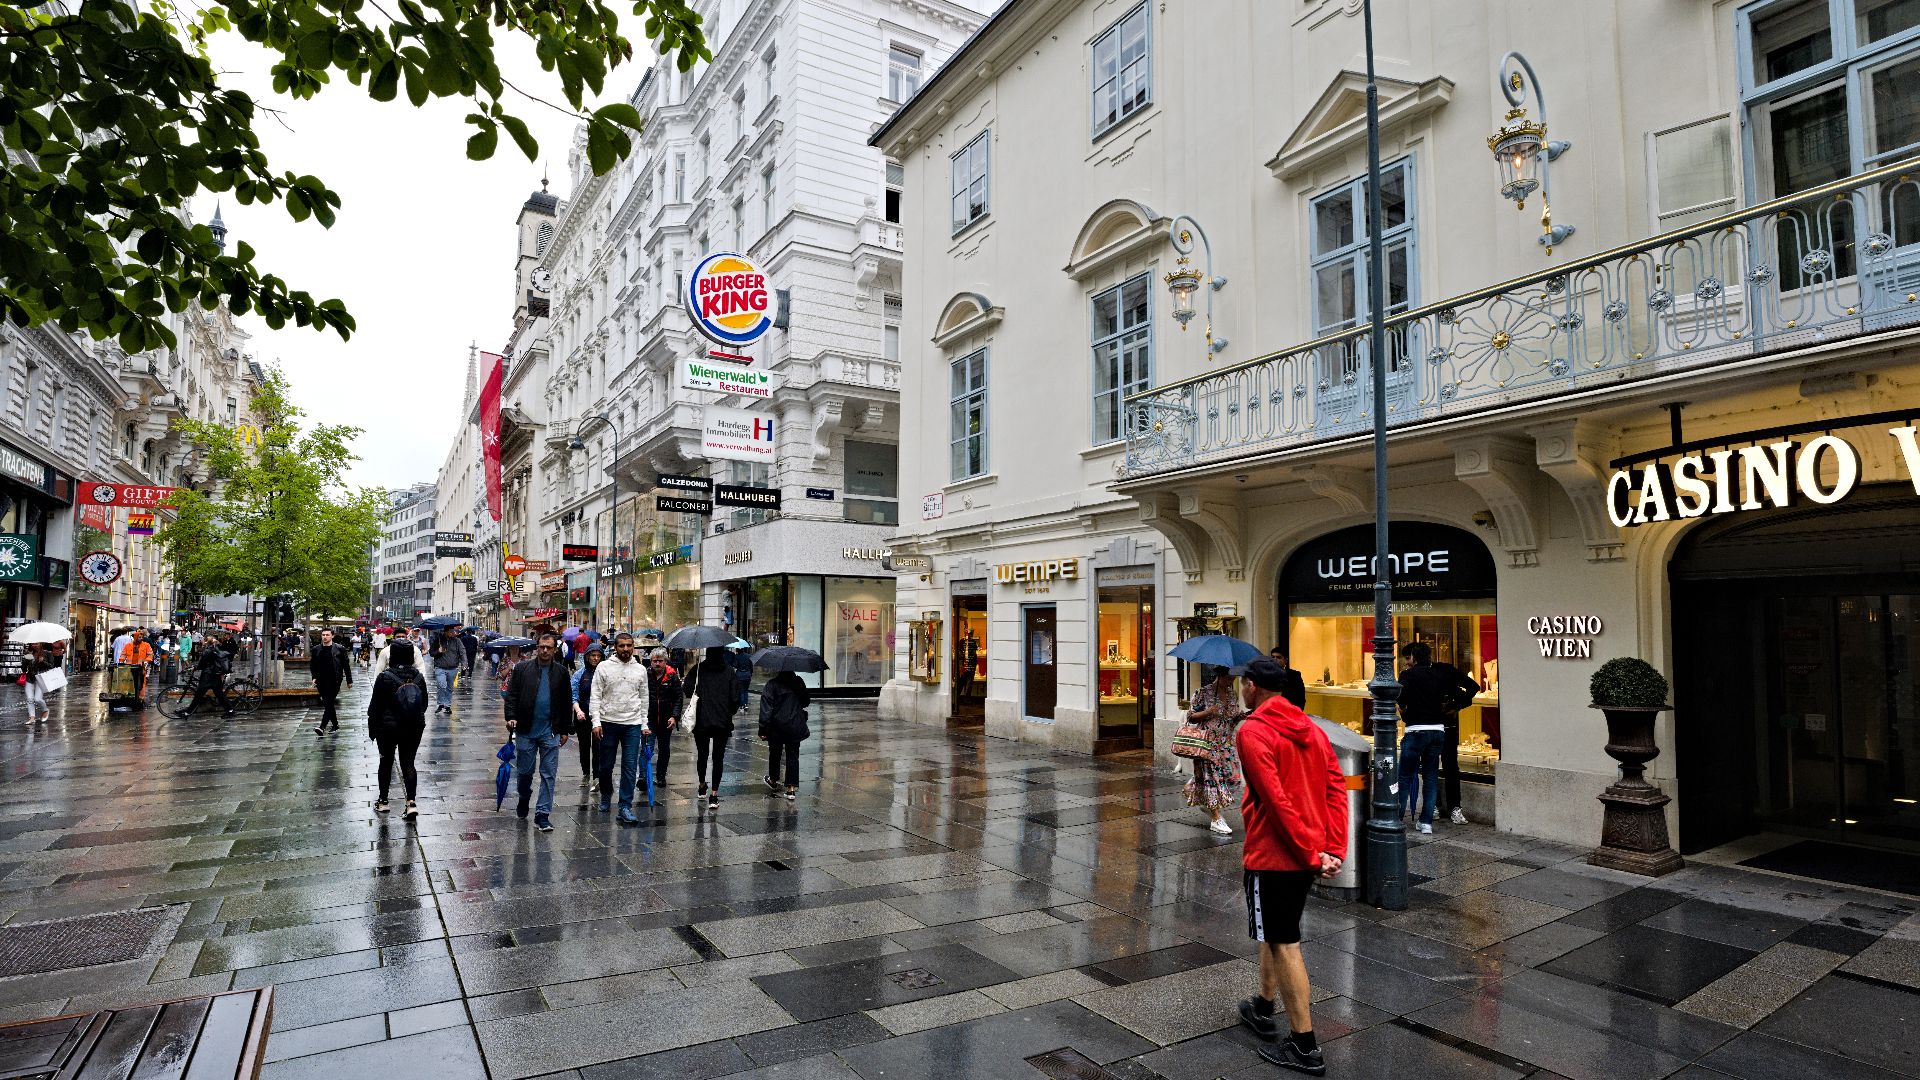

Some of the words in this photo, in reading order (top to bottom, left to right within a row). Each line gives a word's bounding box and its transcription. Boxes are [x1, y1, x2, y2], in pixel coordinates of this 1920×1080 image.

[699, 274, 765, 296] BURGER
[702, 289, 768, 319] KING
[688, 363, 756, 384] Wienerwald
[719, 381, 769, 397] Restaurant
[706, 427, 751, 440] Immobilien
[753, 417, 773, 442] H
[2, 449, 40, 484] TRACHTEN
[661, 477, 708, 488] CALZEDONIA
[1607, 435, 1860, 528] CASINO
[660, 500, 709, 511] FALCONERI
[720, 491, 776, 503] HALLHUBER
[85, 554, 118, 566] PLANET
[1317, 550, 1449, 579] WEMPE
[84, 570, 116, 582] VIENNA
[995, 559, 1077, 583] WEMPE
[1395, 580, 1438, 588] JUWELEN
[842, 608, 878, 621] SALE
[1527, 615, 1602, 635] CASINO
[1537, 638, 1592, 658] WIEN
